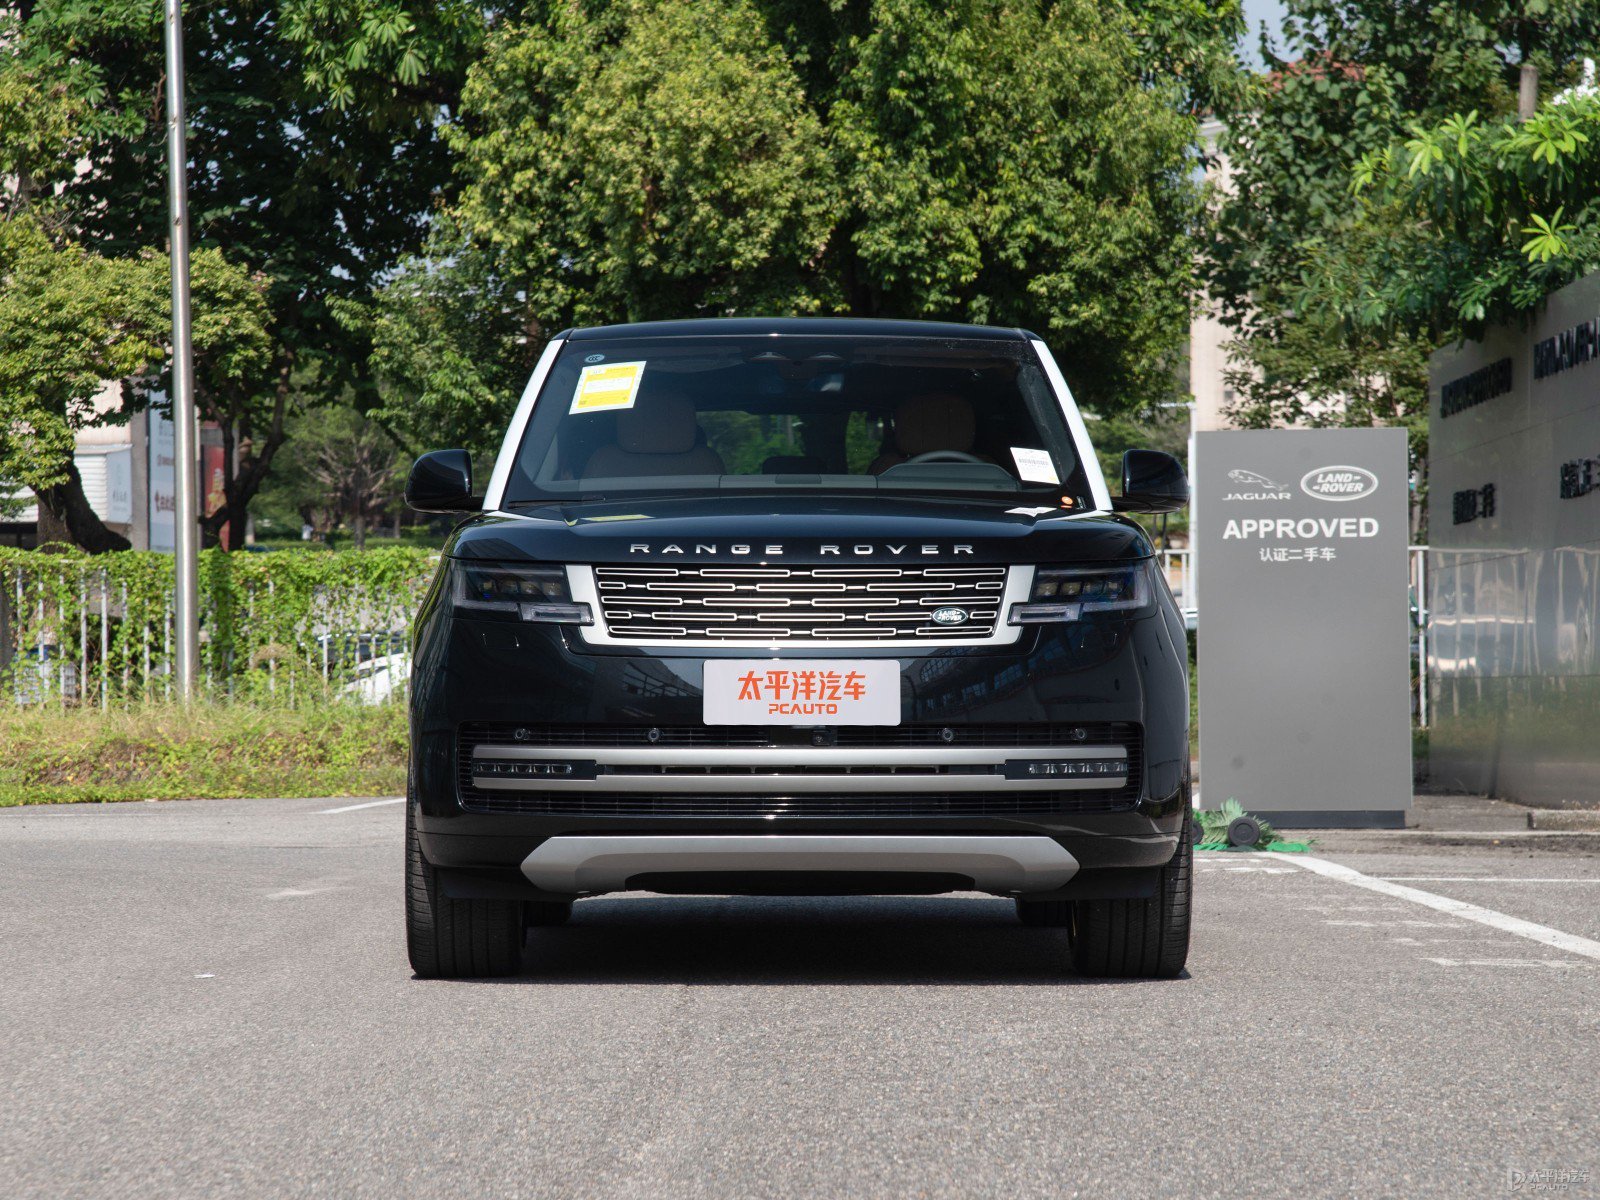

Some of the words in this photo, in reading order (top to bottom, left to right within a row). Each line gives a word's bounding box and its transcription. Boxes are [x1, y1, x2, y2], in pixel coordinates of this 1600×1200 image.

[1222, 492, 1291, 500] JAGUAR
[1222, 518, 1379, 539] APPROVED
[629, 544, 784, 555] RANGE
[820, 544, 974, 555] ROVER
[1259, 547, 1336, 562] 认证二手车
[737, 670, 866, 701] 太平洋汽车
[768, 703, 838, 714] PCAUTO
